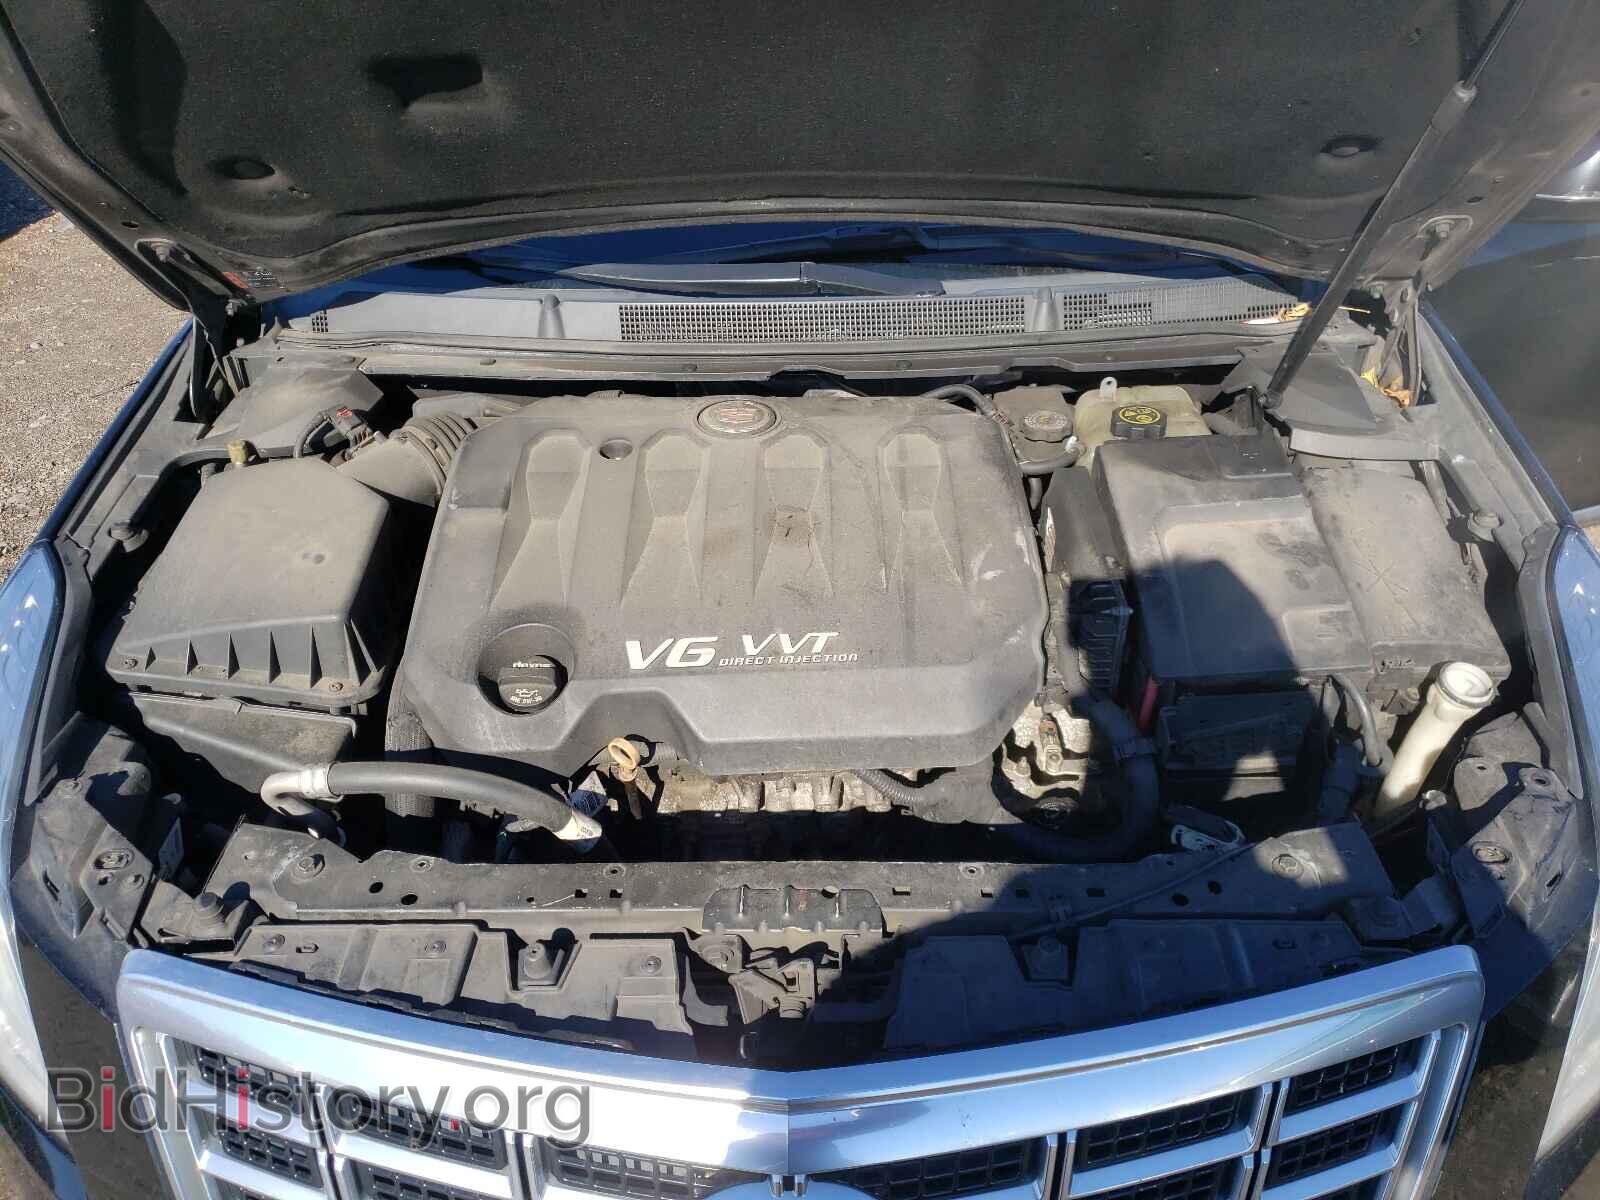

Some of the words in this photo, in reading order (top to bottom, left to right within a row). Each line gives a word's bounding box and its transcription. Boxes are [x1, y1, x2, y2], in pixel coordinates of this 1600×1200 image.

[625, 636, 719, 670] V6
[741, 632, 840, 656] VVT
[719, 655, 776, 667] DIRECT
[779, 653, 859, 665] INJECTION
